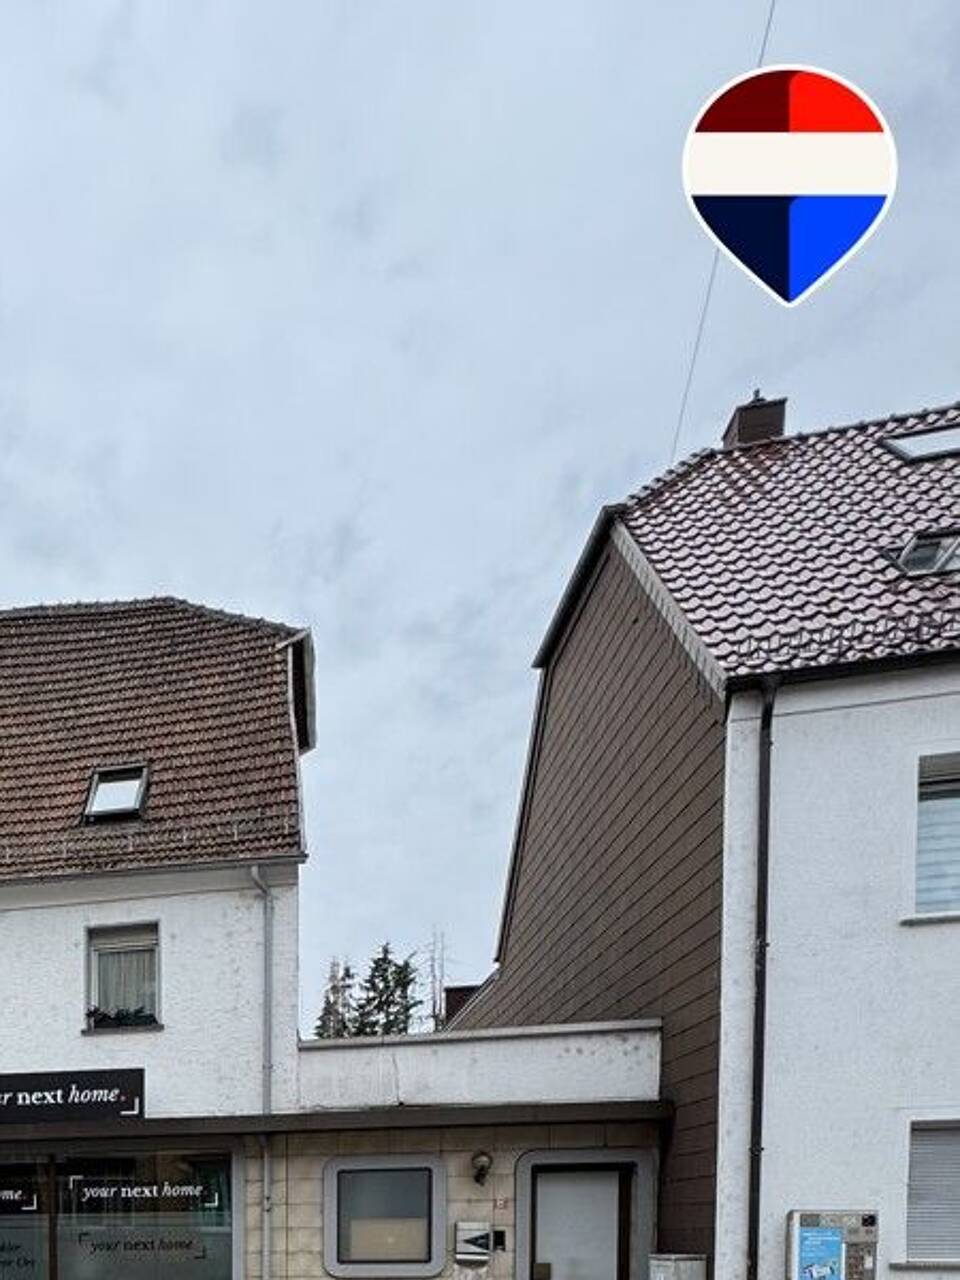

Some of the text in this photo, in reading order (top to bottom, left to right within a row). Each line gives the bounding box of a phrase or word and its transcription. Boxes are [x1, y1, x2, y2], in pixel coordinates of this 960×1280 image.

[16, 1088, 65, 1105] next
[67, 1084, 127, 1103] home.
[82, 1185, 118, 1202] your
[121, 1183, 159, 1198] next
[90, 1240, 121, 1255] your
[123, 1238, 155, 1252] next
